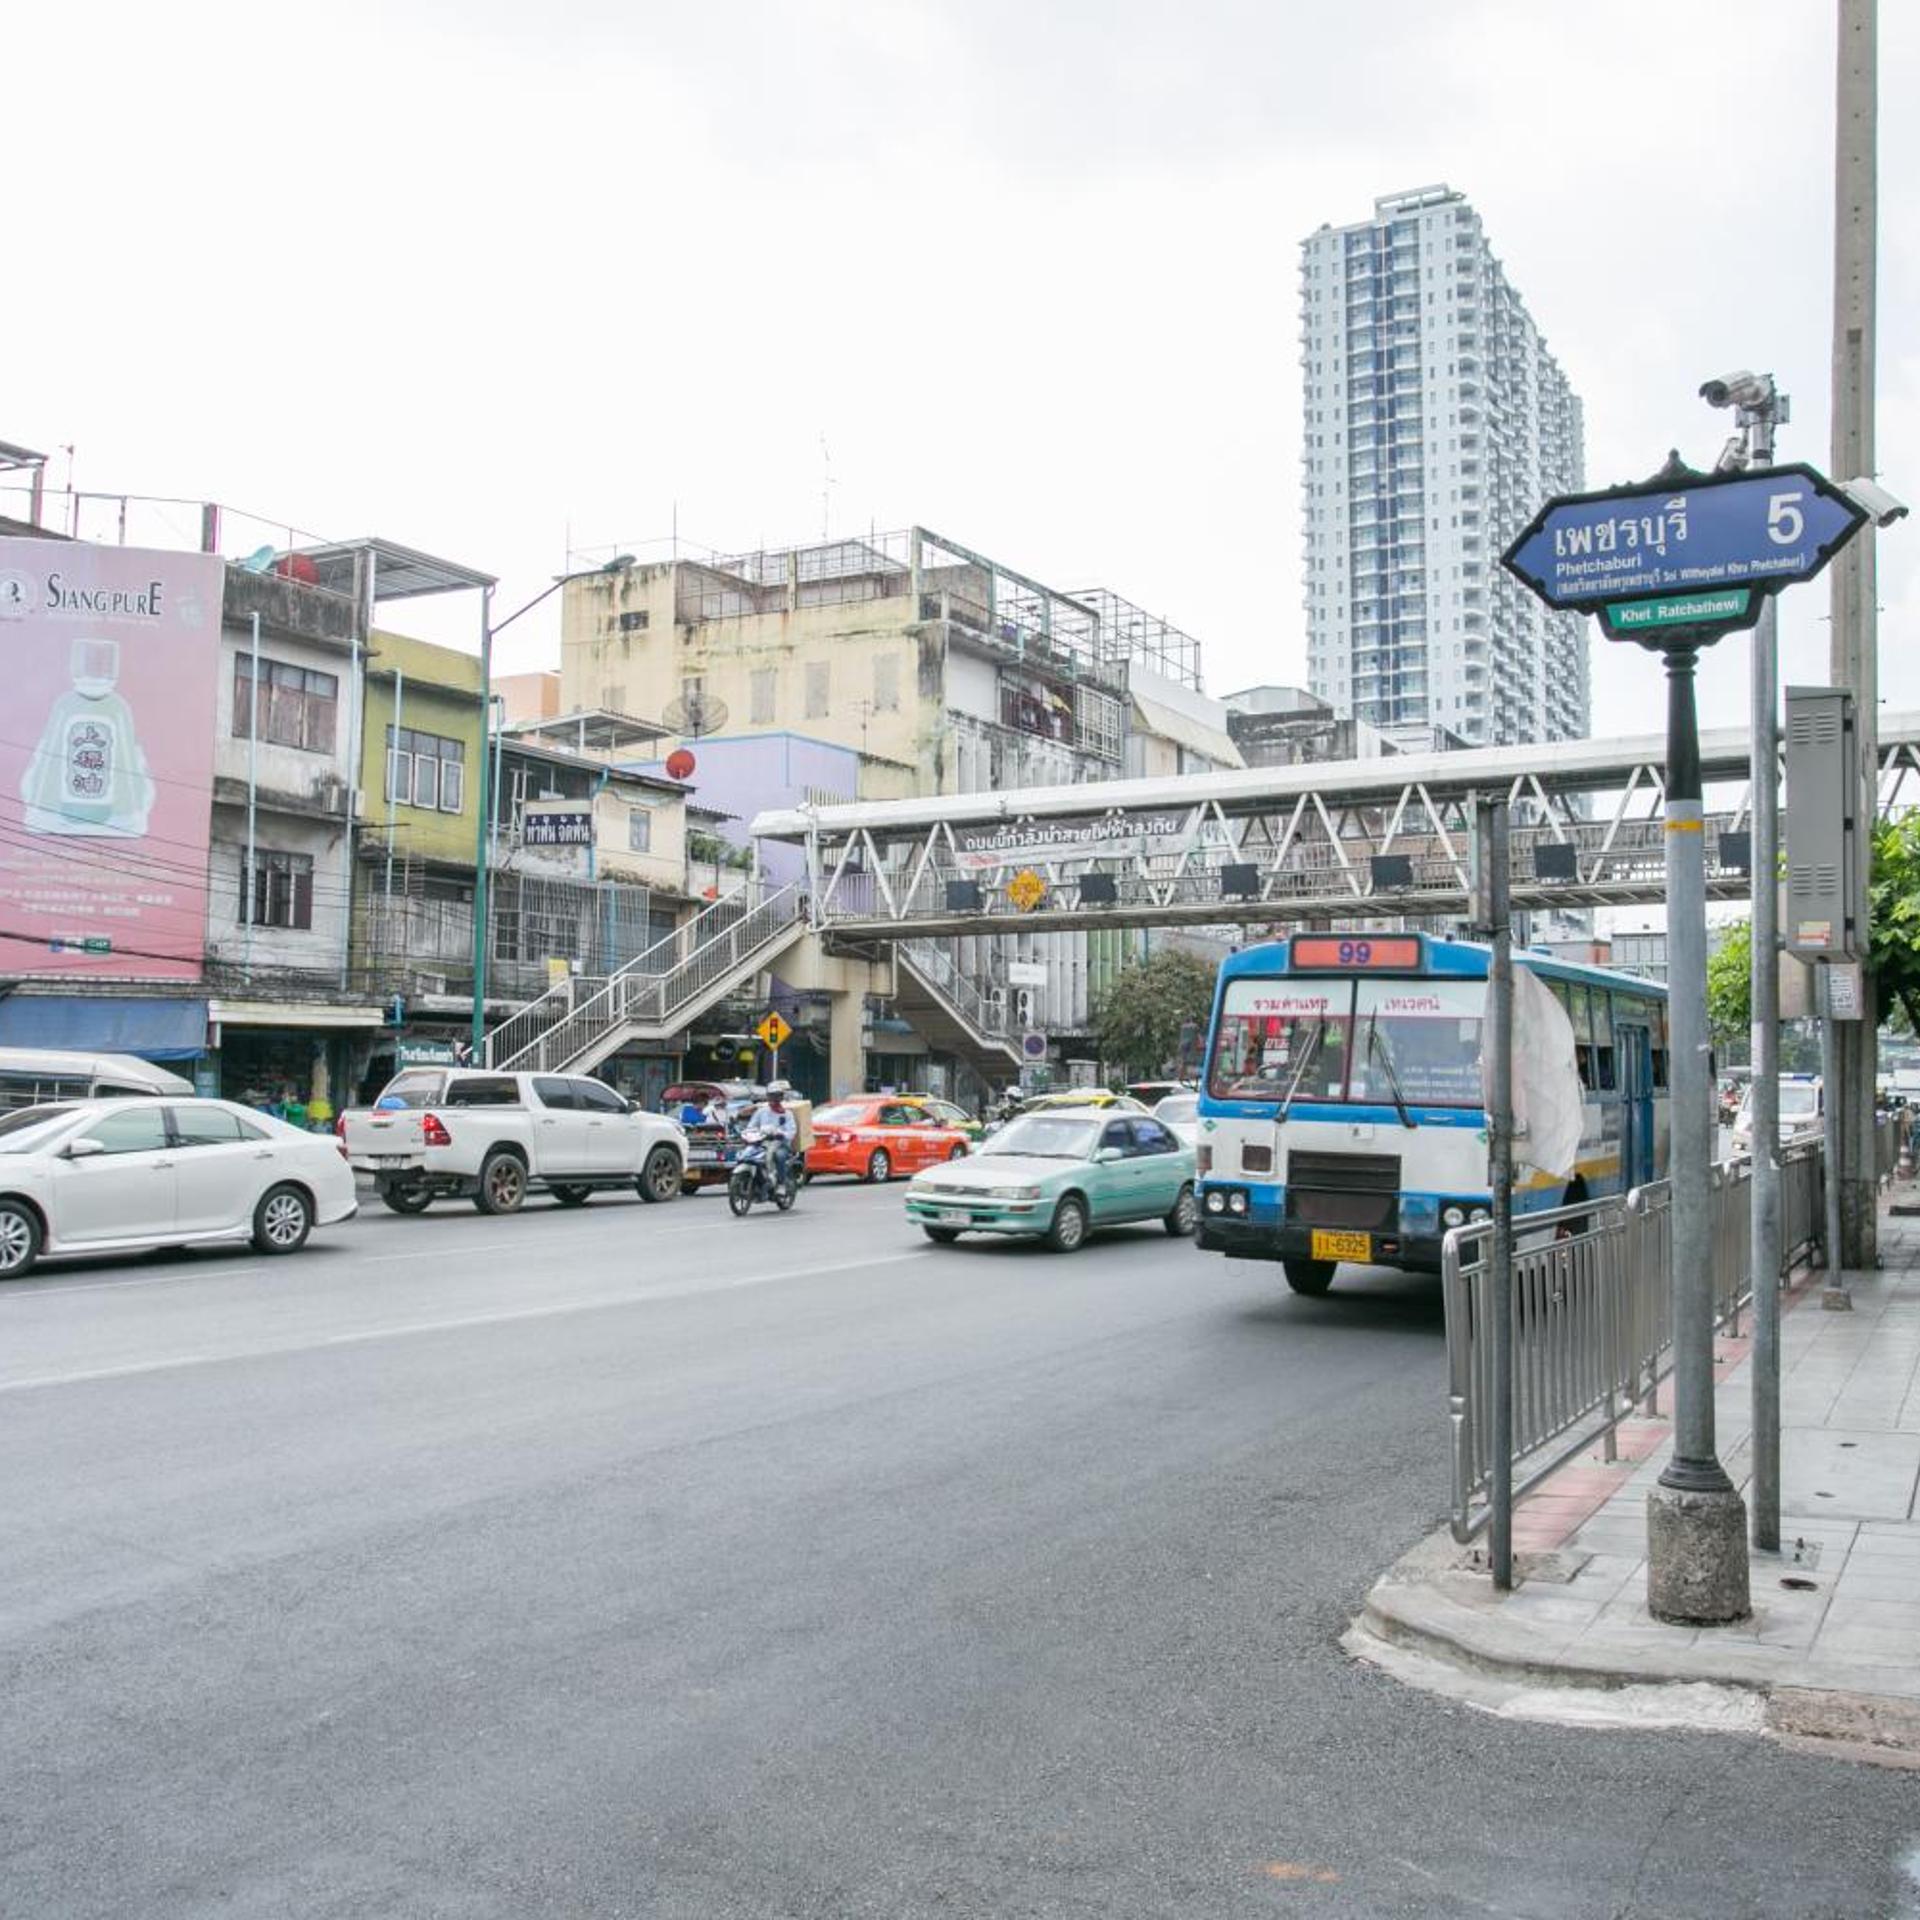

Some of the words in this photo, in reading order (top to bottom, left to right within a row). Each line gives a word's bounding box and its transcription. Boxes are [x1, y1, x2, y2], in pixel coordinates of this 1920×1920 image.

[1555, 496, 1687, 557] เพชรบุรี
[1767, 491, 1804, 545] 5
[1556, 552, 1642, 577] Phetchaburi
[1621, 606, 1651, 623] Khet
[1658, 596, 1739, 620] Ratchathewi
[1338, 941, 1371, 964] 99
